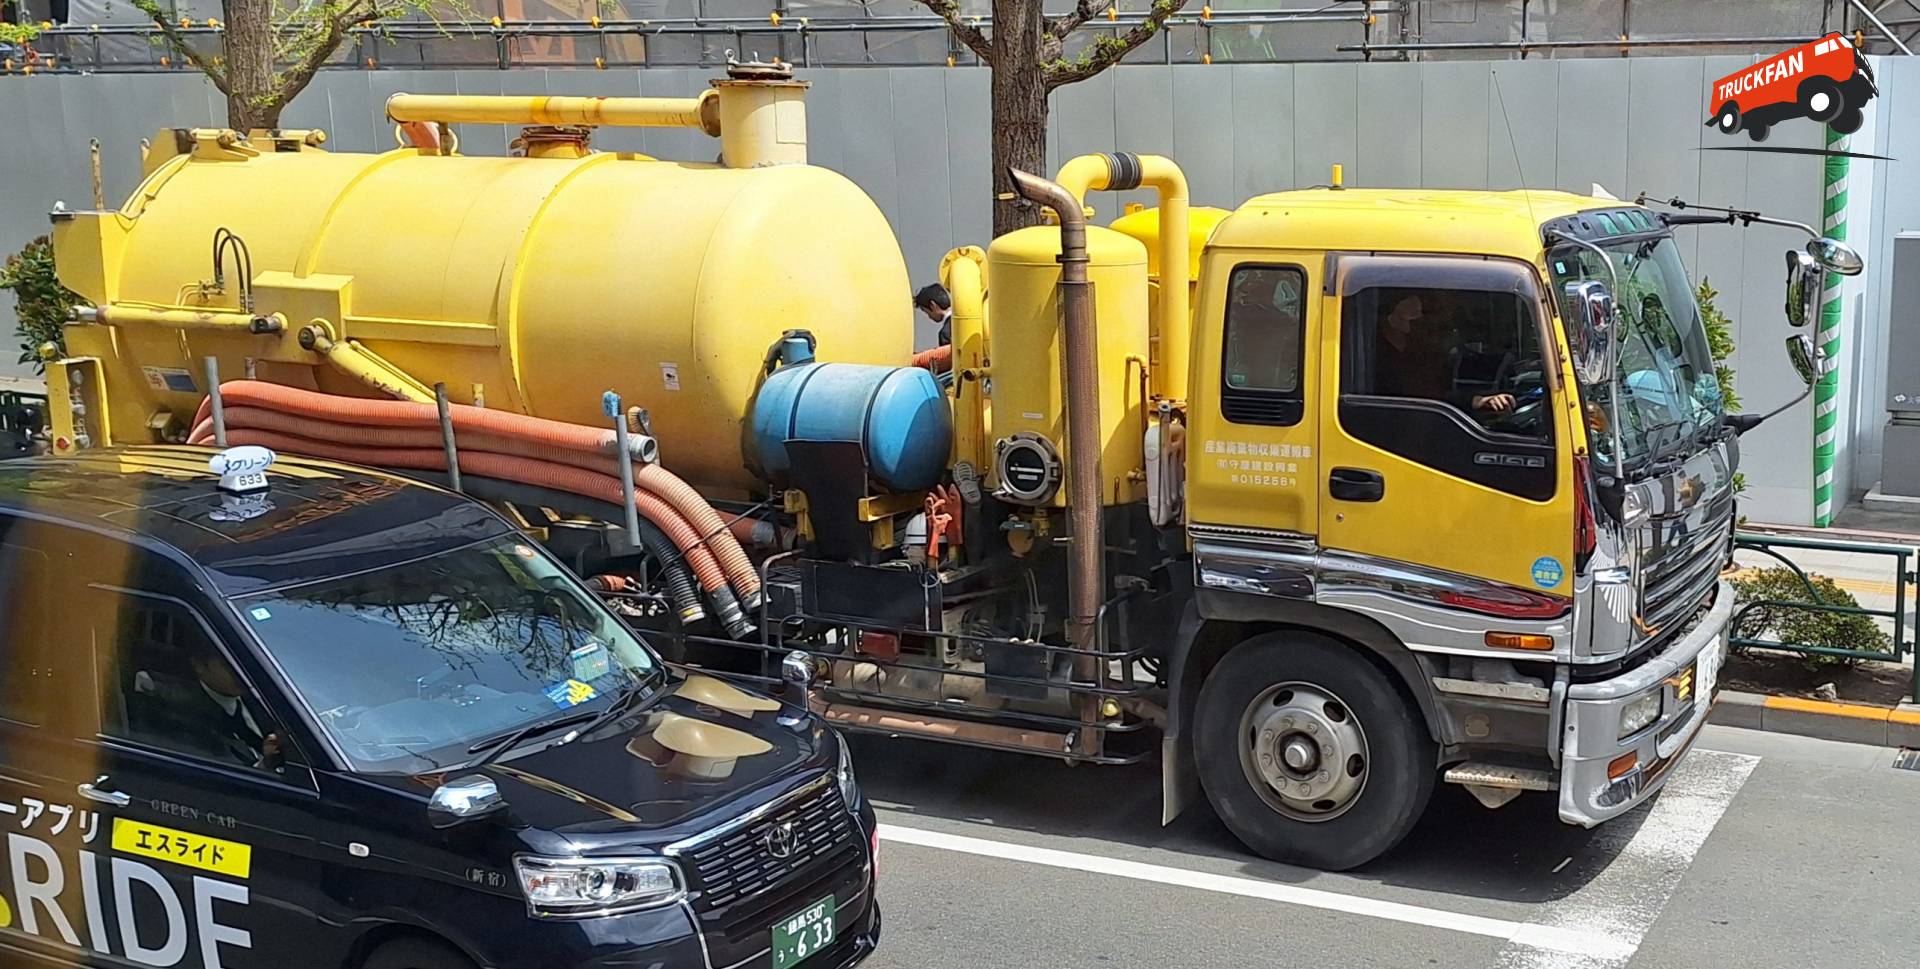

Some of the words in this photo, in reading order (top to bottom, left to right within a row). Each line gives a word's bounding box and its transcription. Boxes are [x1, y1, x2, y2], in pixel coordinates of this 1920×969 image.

[239, 473, 263, 486] 633
[151, 799, 200, 819] GREEN
[206, 812, 237, 829] CAB
[135, 830, 225, 865] エスライド
